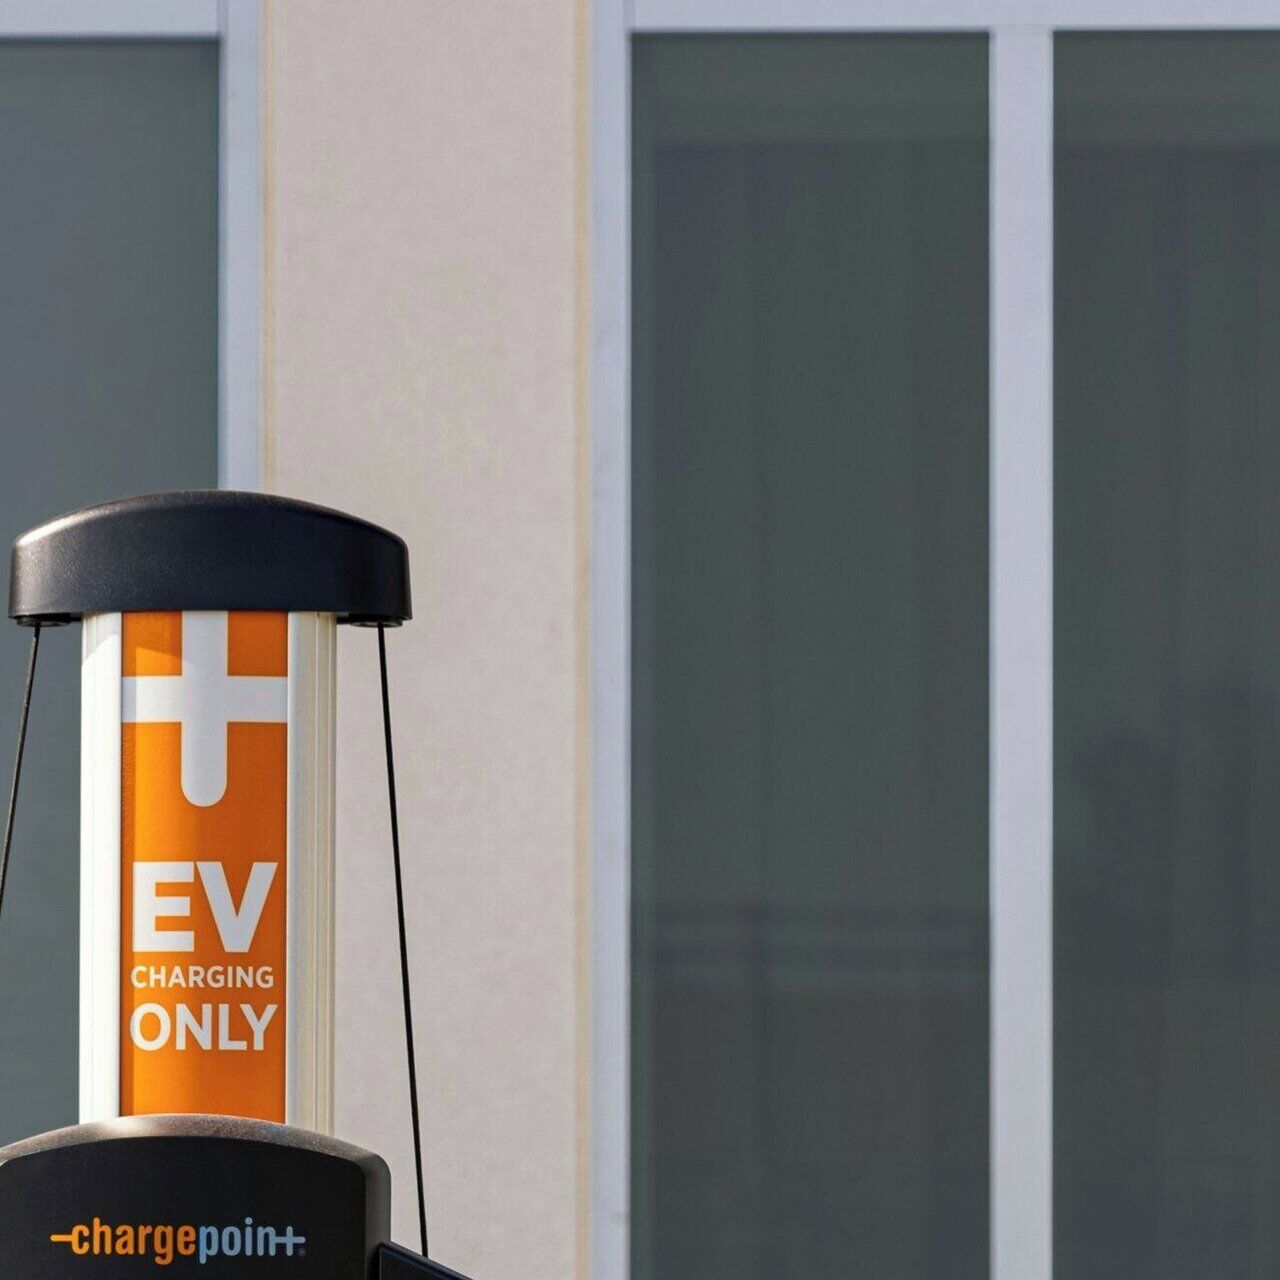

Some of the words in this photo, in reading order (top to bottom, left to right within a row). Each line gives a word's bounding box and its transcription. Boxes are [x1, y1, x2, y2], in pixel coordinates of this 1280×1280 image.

[132, 861, 278, 953] EV
[130, 965, 275, 989] CHARGING
[129, 1002, 278, 1052] ONLY
